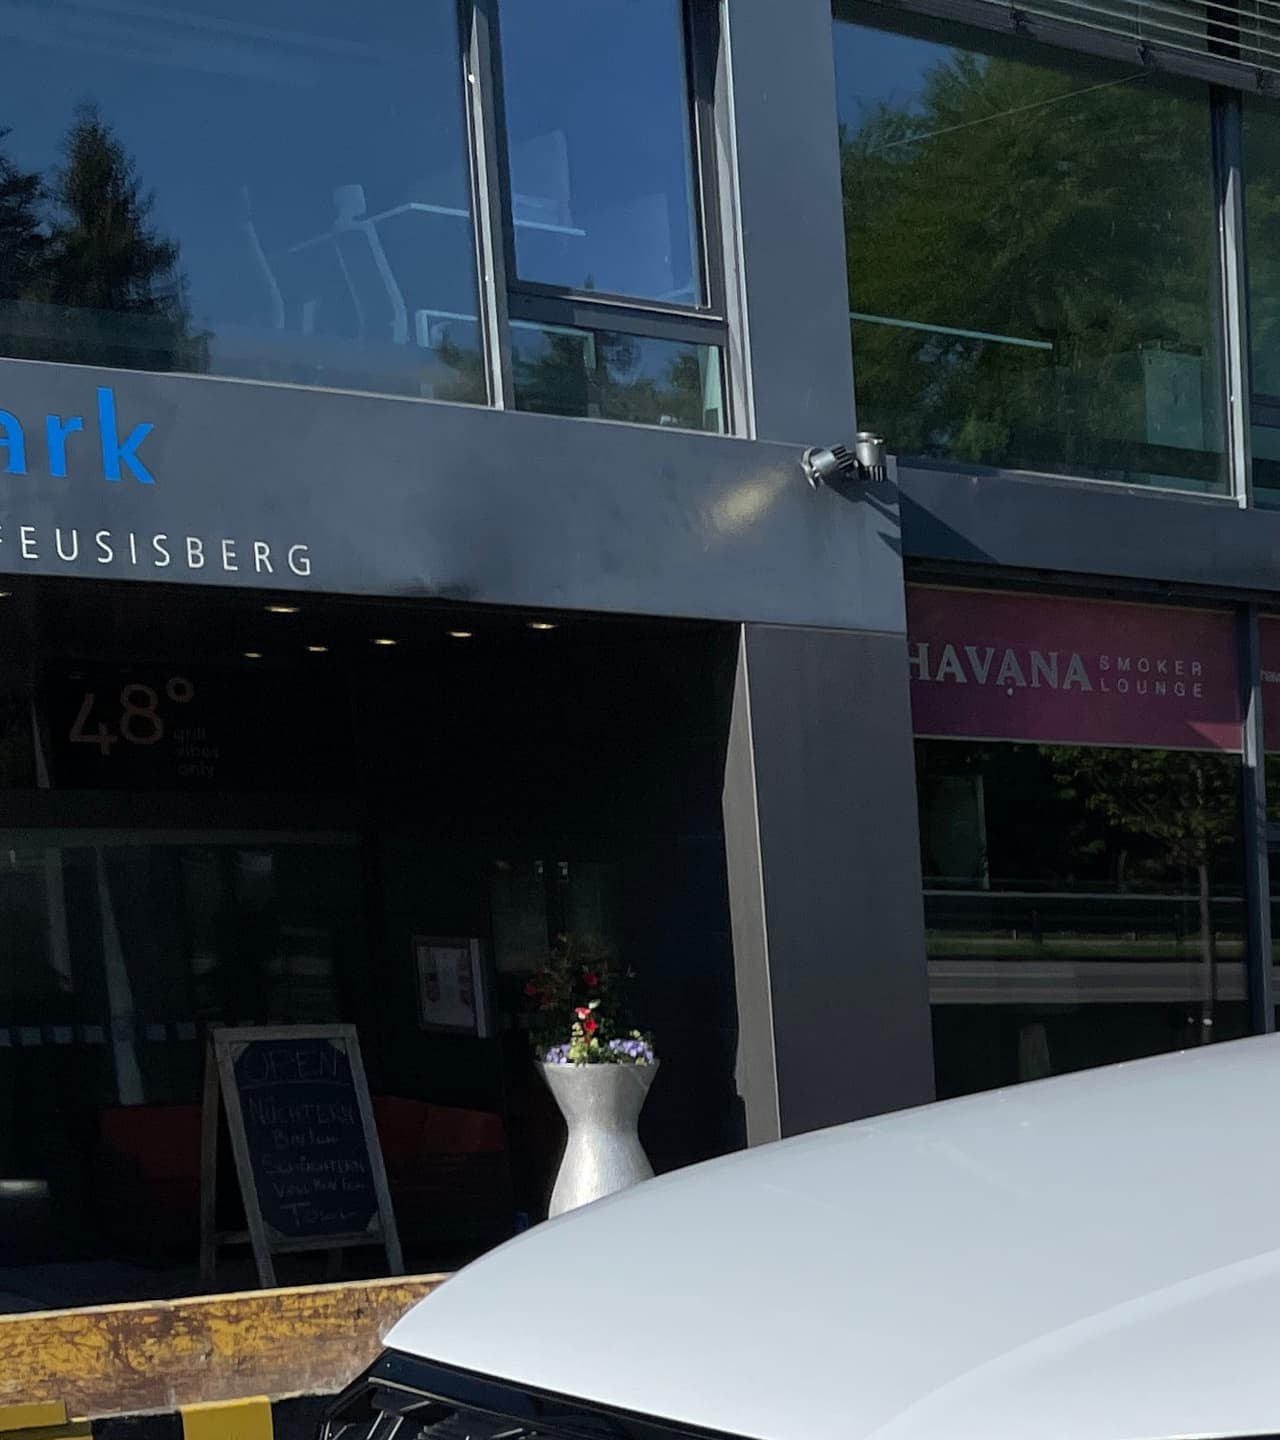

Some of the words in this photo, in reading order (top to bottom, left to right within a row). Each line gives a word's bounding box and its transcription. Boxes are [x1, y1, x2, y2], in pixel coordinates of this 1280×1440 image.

[909, 643, 1092, 691] HAVANA
[1099, 655, 1203, 676] SMOKER
[1099, 677, 1203, 698] LOUNGE
